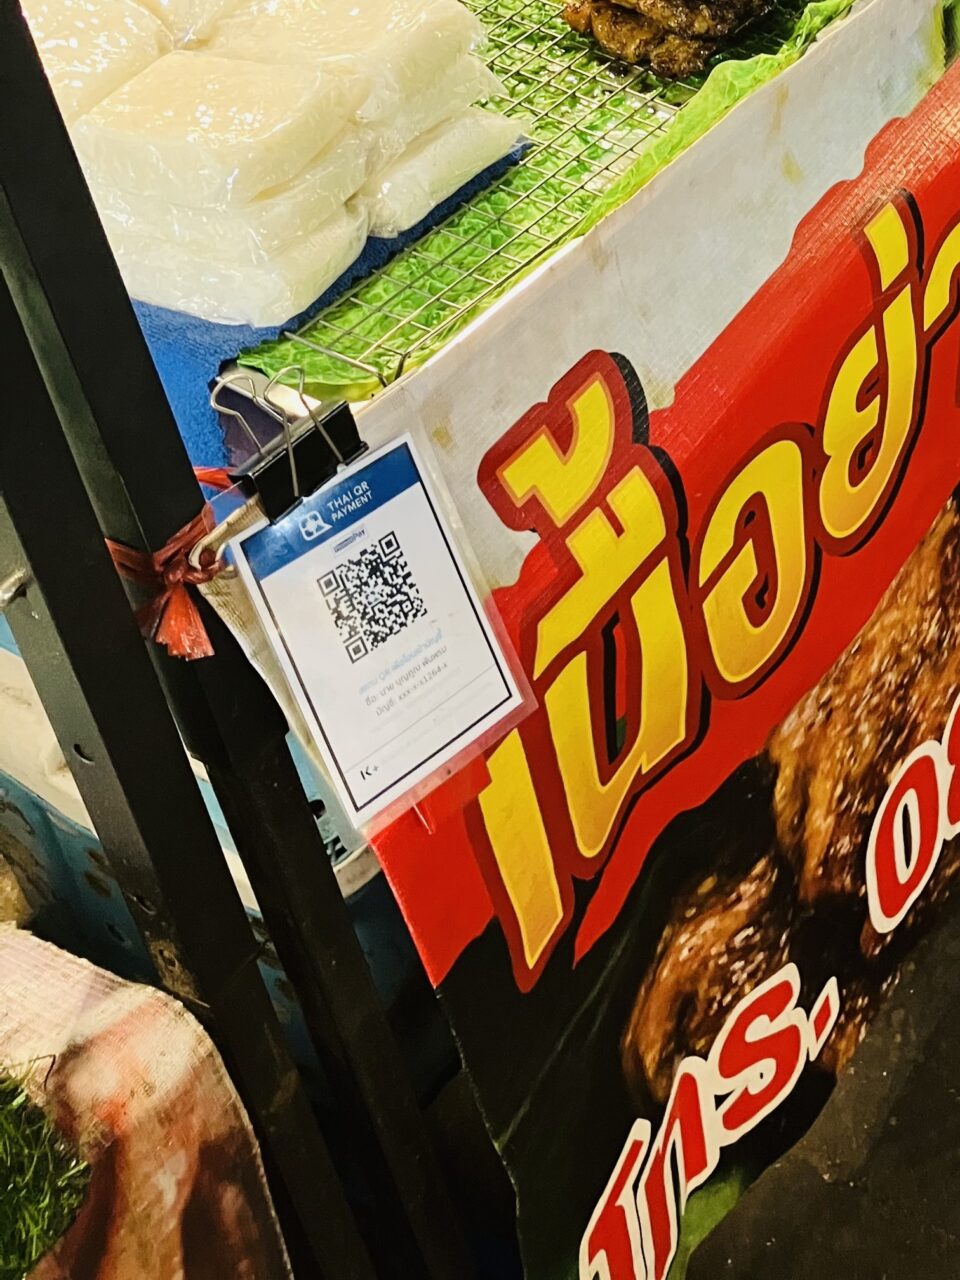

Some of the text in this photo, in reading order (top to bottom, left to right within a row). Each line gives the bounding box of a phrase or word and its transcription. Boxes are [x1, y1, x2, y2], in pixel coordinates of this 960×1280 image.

[327, 480, 370, 512] THAI QR
[331, 490, 373, 523] PAYMENT
